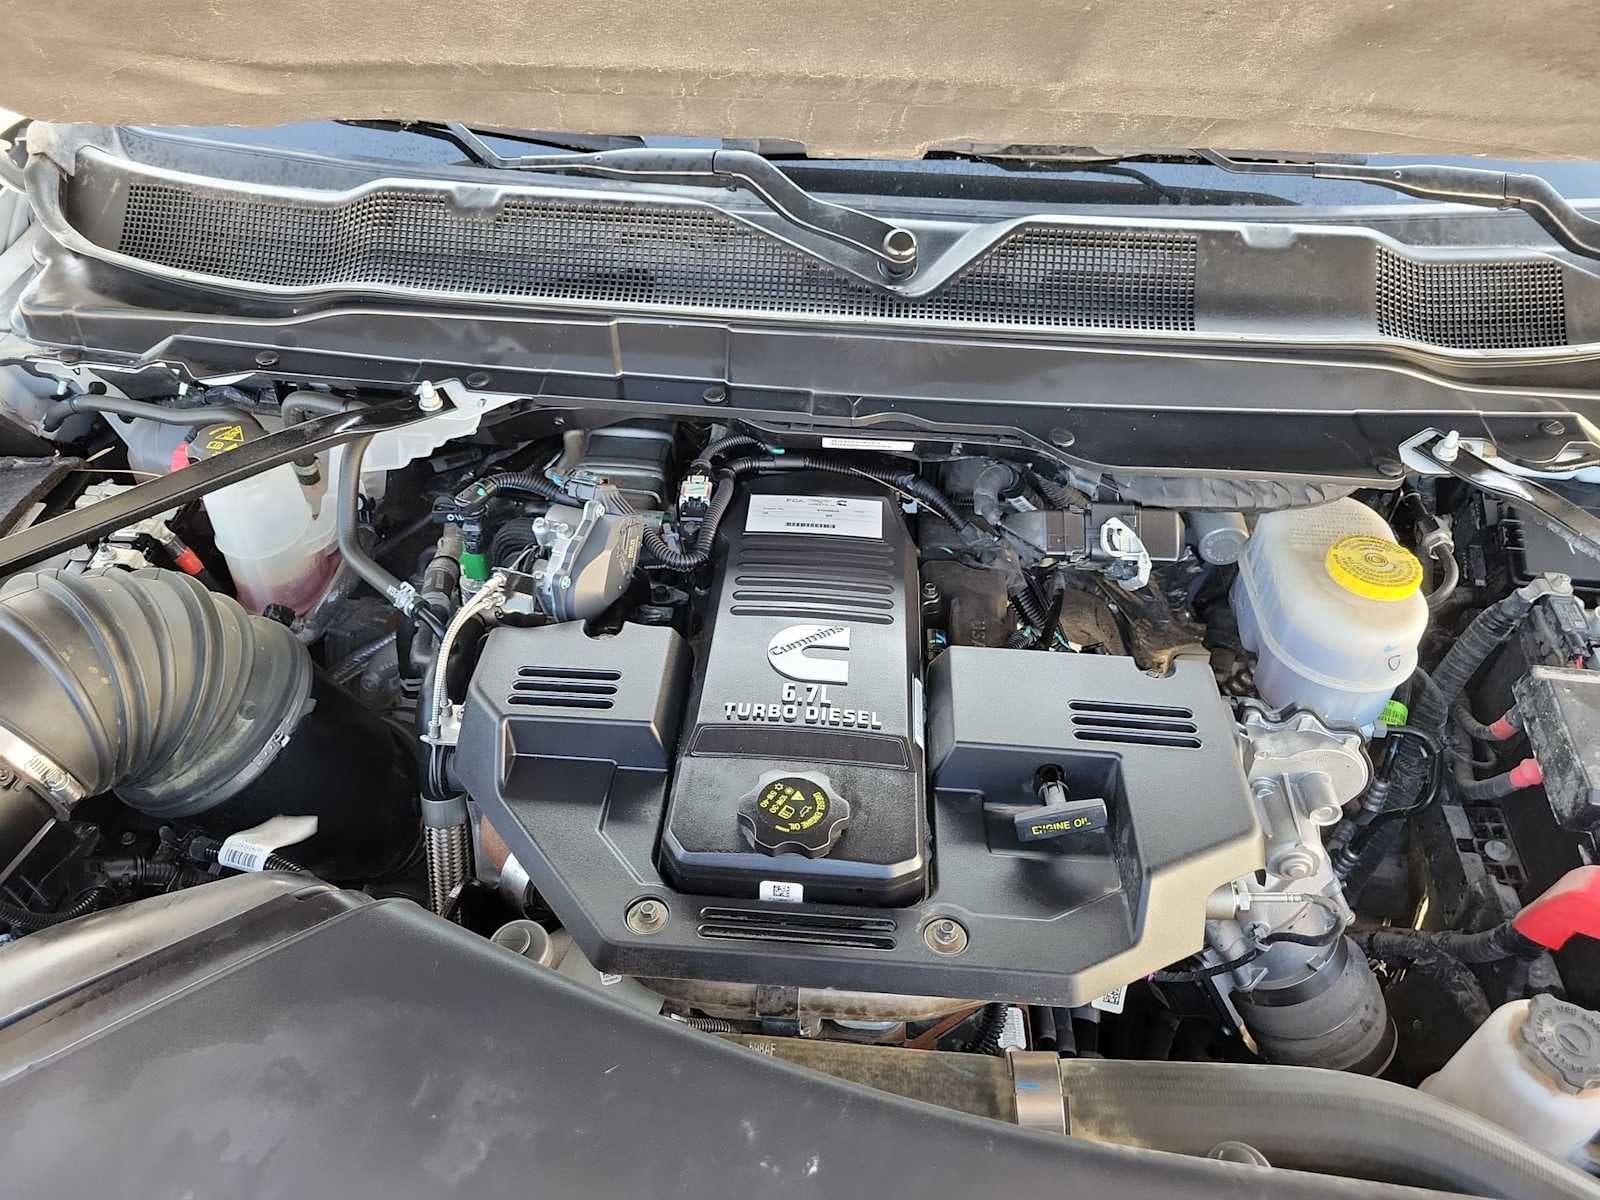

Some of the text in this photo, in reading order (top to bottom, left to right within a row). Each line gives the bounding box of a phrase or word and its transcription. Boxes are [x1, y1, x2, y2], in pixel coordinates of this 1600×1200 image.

[769, 625, 844, 656] Cummins
[782, 683, 832, 706] 6.7L
[724, 702, 882, 730] TURBO DIESEL
[1031, 817, 1091, 835] ENGINE OIL
